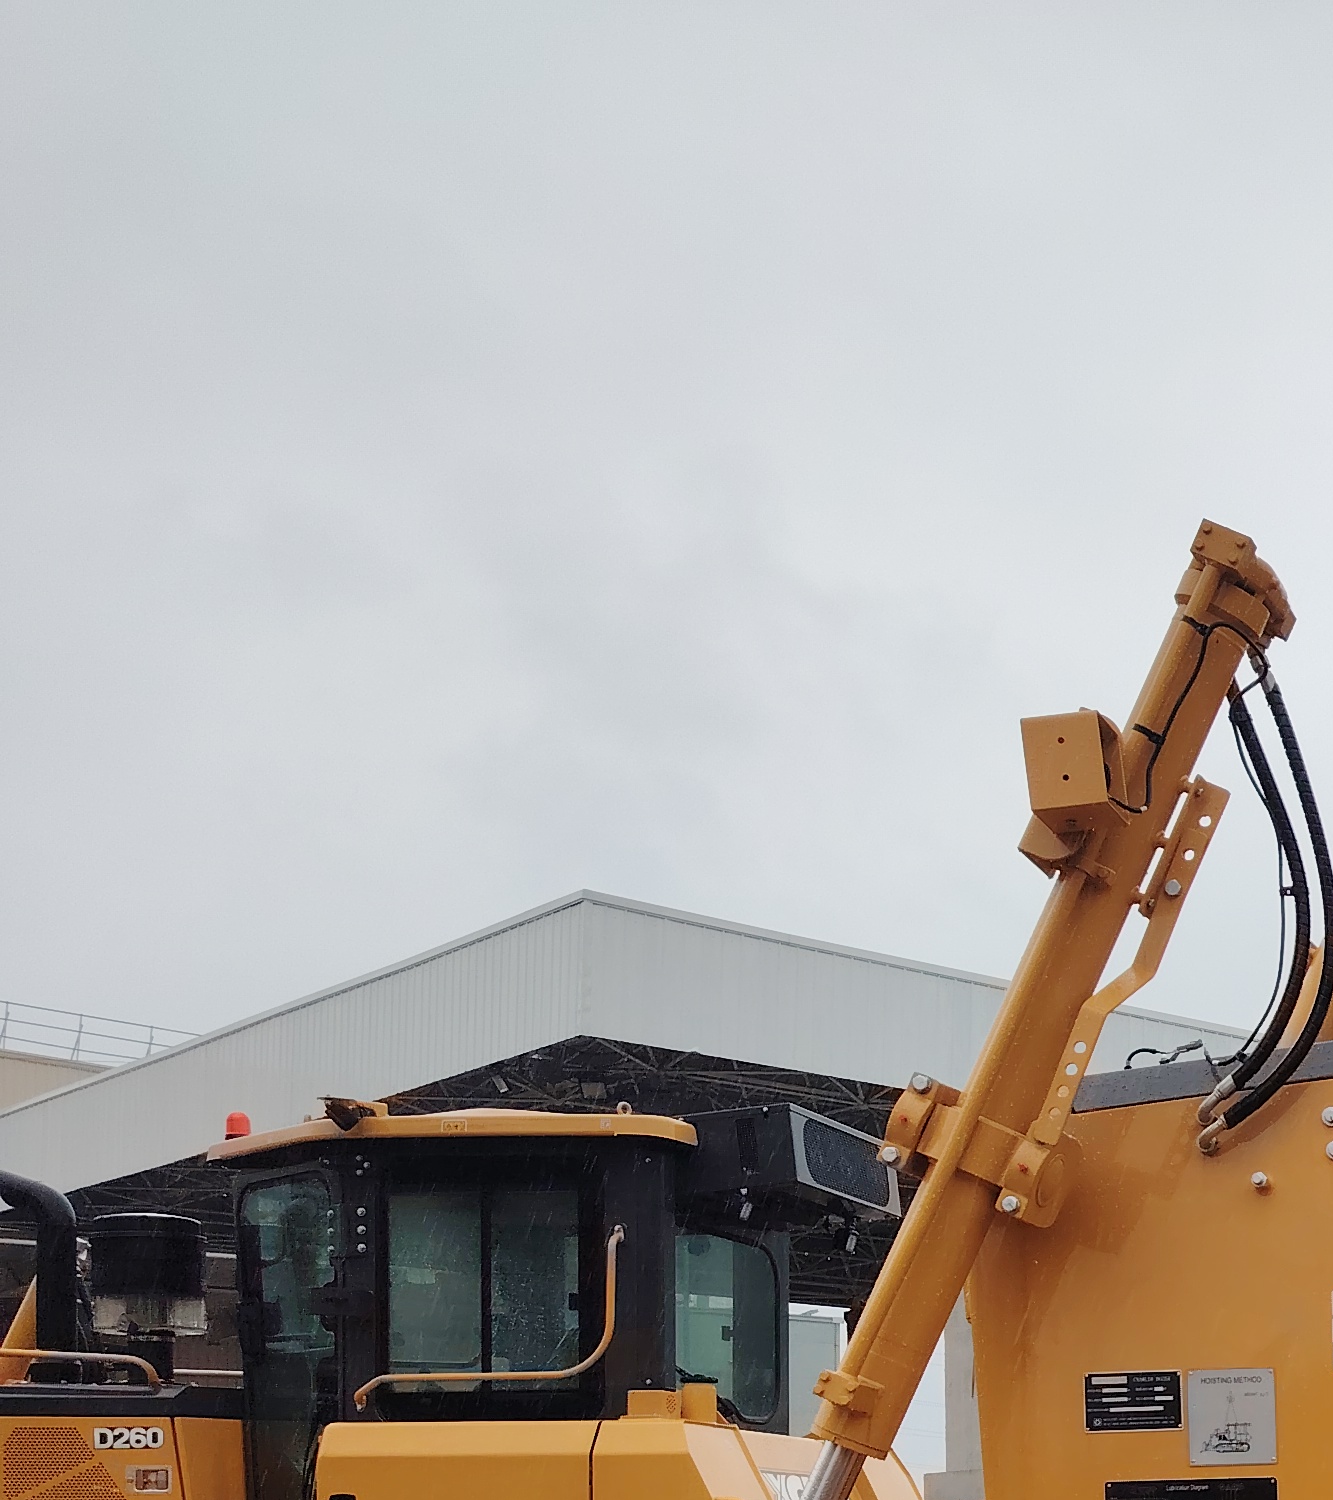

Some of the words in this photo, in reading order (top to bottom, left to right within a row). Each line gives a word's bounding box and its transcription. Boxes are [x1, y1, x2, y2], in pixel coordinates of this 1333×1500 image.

[1200, 1377, 1232, 1385] HOISTING
[1233, 1375, 1263, 1384] METHOD
[94, 1427, 164, 1449] D260
